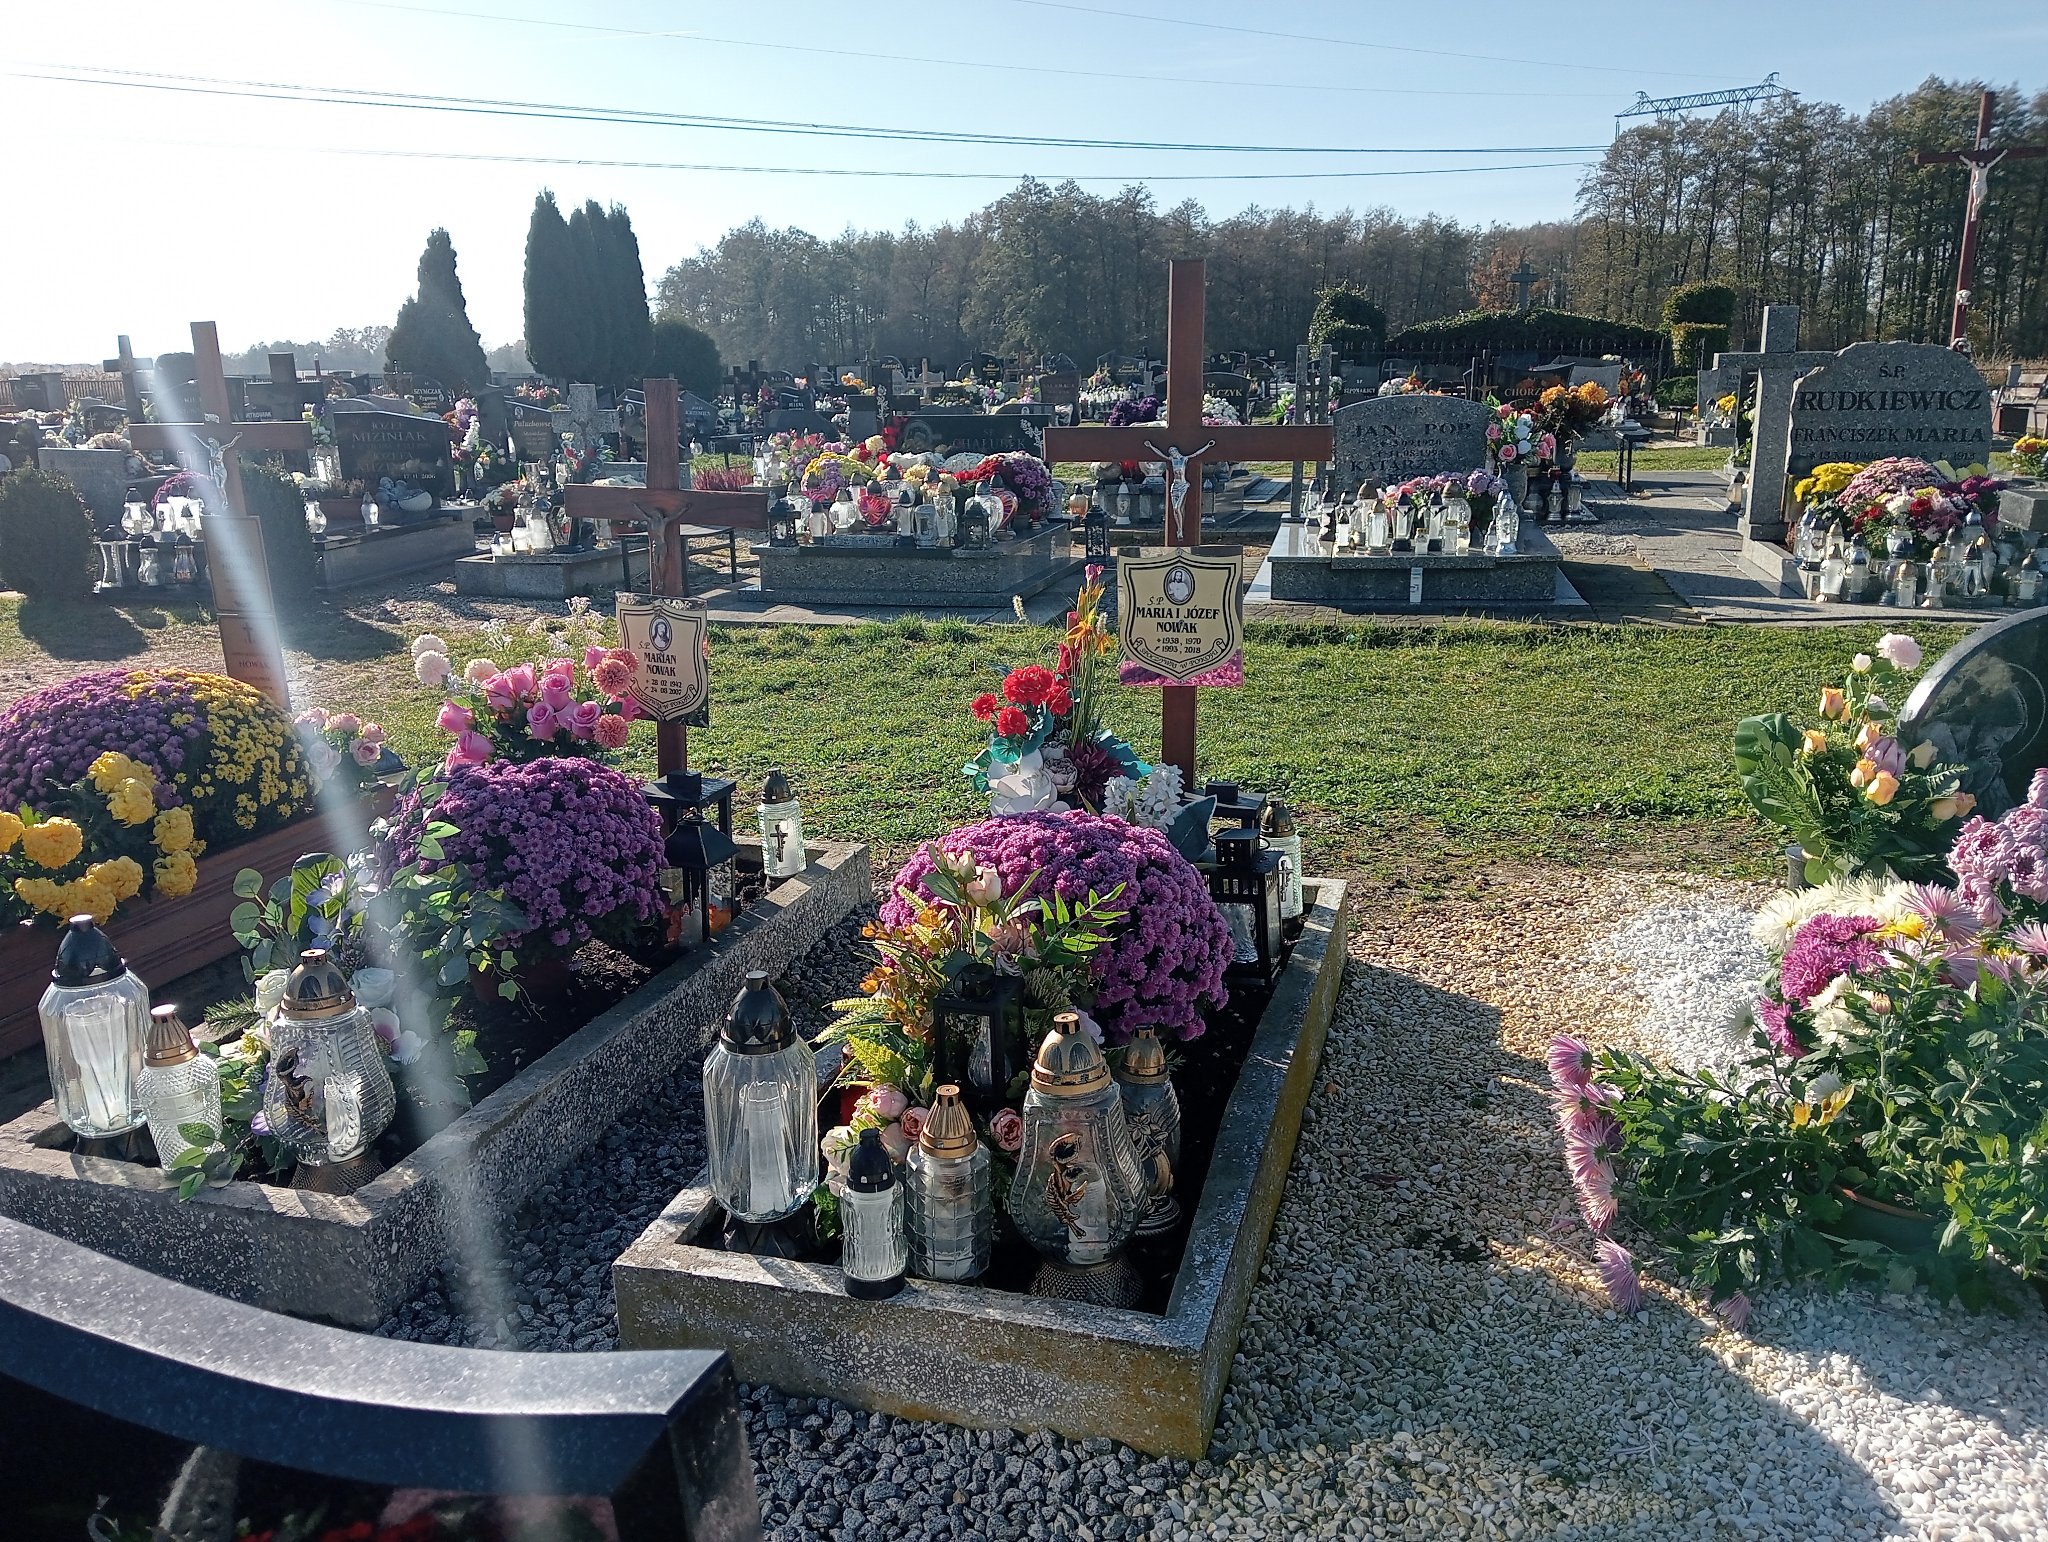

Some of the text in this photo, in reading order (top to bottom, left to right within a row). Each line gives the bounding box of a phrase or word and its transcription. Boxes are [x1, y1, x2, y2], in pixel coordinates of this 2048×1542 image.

[1797, 389, 1984, 412] RUDKIEWICZ
[1355, 422, 1472, 438] JAN POP
[1795, 427, 1985, 444] FRANCISZEK MARIA
[1136, 604, 1220, 620] MARIA I JÓZEF
[1156, 621, 1198, 634] NOWAK
[1185, 637, 1202, 645] 1970
[1184, 646, 1201, 654] 2018
[643, 651, 677, 665] MARIAN
[645, 664, 677, 677] NOWAK
